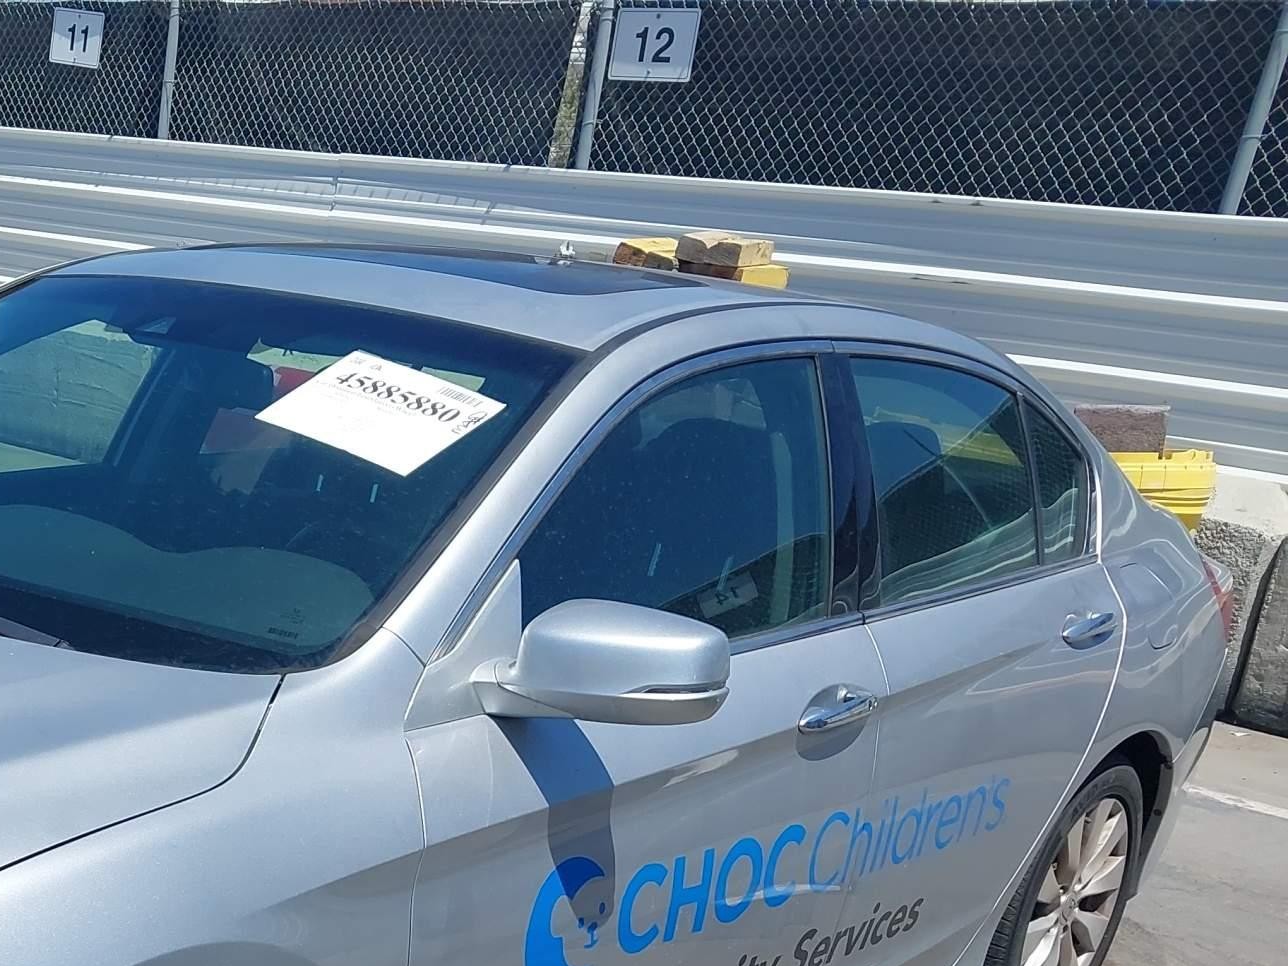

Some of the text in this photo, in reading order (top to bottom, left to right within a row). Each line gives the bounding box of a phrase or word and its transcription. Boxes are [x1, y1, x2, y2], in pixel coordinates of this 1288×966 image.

[67, 23, 89, 53] 11
[635, 26, 675, 63] 12
[335, 372, 461, 423] 45885880
[617, 774, 1011, 955] CHOC Children's
